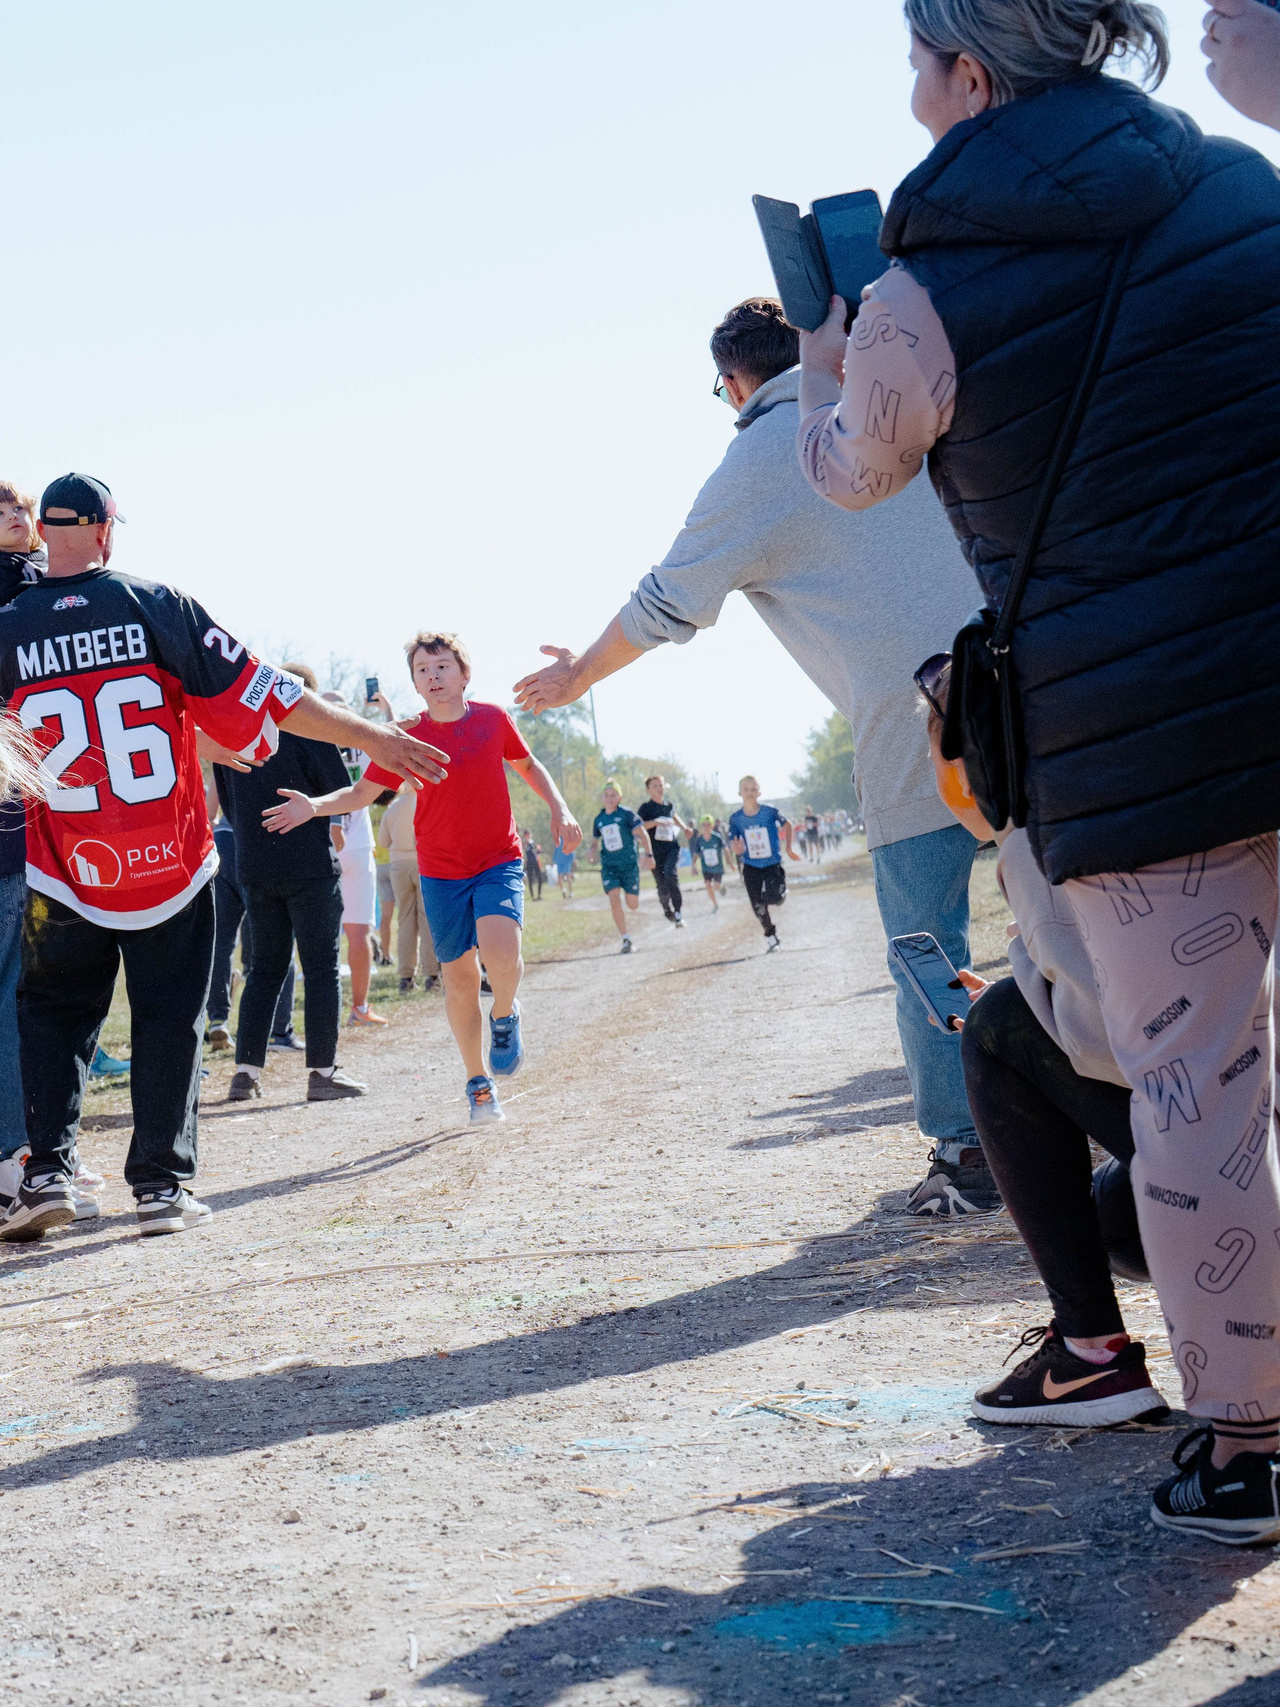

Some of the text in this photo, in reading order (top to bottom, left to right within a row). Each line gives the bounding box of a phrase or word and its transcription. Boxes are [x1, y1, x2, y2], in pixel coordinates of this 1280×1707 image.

[16, 623, 147, 681] МАТВЕЕВ
[18, 673, 178, 813] 26
[126, 840, 177, 867] РСК
[1142, 995, 1192, 1040] MOSCHINO
[1219, 1045, 1261, 1086] MOSCHINO
[1144, 1182, 1200, 1212] MOSCHINO
